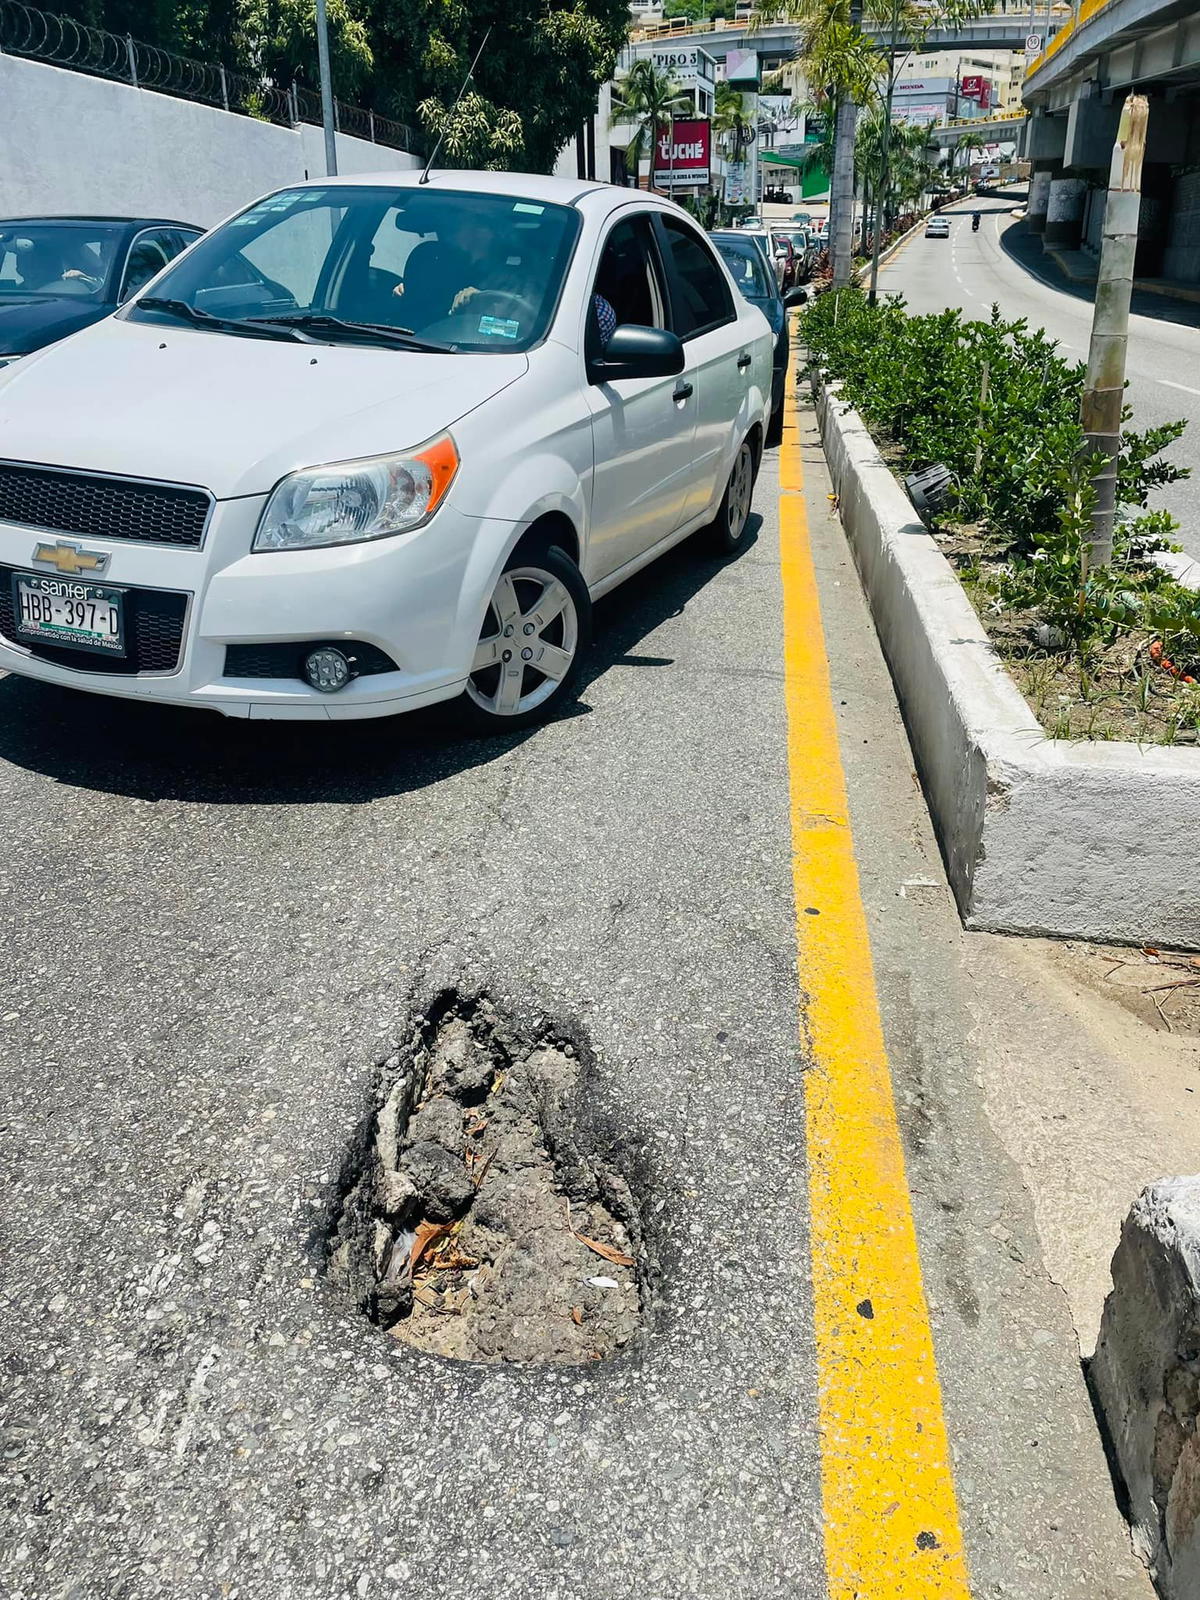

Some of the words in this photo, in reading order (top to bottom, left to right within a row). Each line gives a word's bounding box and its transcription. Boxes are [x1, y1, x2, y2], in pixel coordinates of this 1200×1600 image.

[657, 54, 687, 65] PISO
[690, 53, 697, 64] 3
[661, 139, 704, 159] CUCHÉ
[41, 580, 89, 600] sanfer
[77, 636, 93, 645] salud
